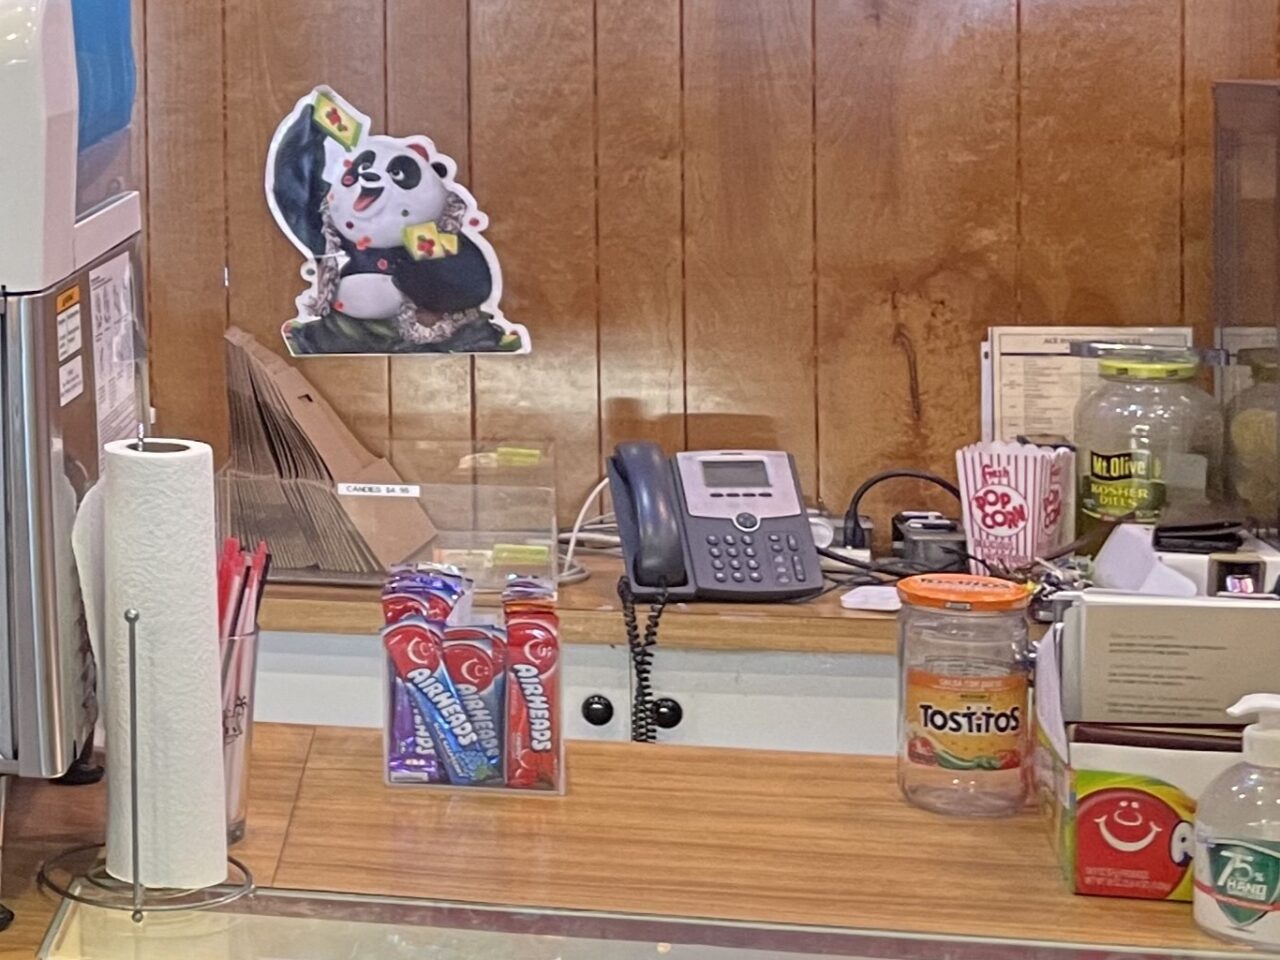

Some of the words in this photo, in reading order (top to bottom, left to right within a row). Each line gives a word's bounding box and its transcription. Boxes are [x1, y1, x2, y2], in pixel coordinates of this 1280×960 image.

[1091, 483, 1149, 498] KOSHER
[407, 668, 478, 746] AIRHEADS
[513, 664, 552, 751] AIRHEADS
